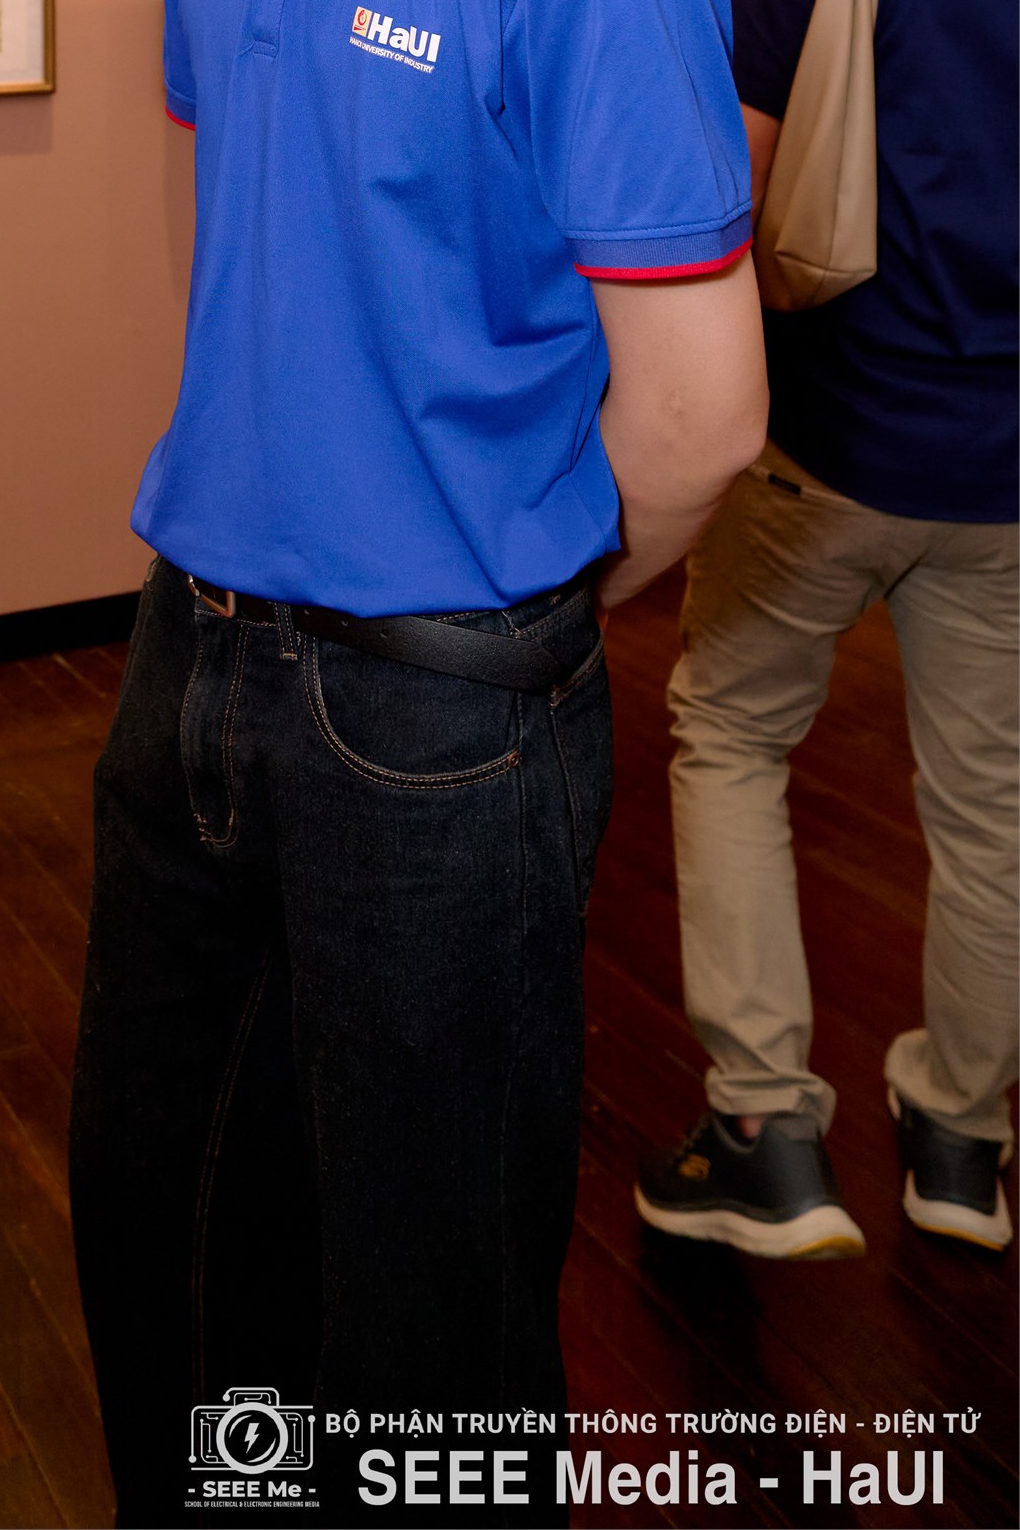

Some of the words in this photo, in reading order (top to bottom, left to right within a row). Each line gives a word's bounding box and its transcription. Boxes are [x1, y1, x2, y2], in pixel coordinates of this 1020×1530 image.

[361, 41, 396, 59] UNIVERSITY
[394, 52, 405, 62] OF
[403, 56, 436, 74] INDUSTRY
[367, 11, 441, 63] HaUI
